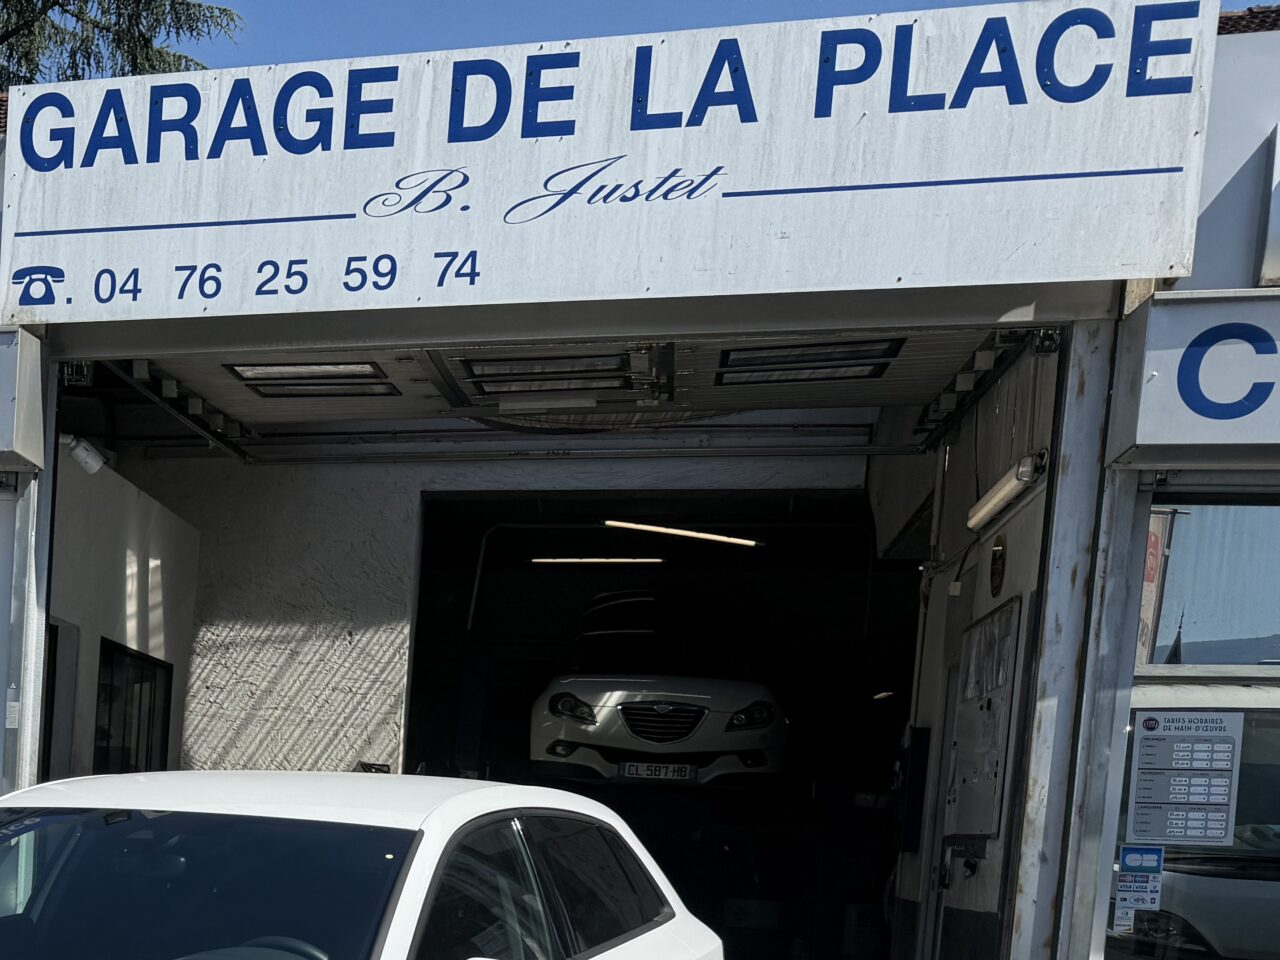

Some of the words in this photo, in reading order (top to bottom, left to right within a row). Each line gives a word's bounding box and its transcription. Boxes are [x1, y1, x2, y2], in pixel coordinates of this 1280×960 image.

[19, 66, 399, 173] GARAGE
[447, 51, 581, 144] DE
[629, 38, 758, 131] LA
[814, 1, 1200, 119] PLACE
[363, 165, 470, 219] B.
[503, 155, 728, 225] Justet
[93, 267, 142, 304] 04
[173, 263, 222, 301] 76
[255, 259, 309, 297] 25
[343, 254, 398, 292] 59
[433, 250, 480, 288] 74
[1163, 717, 1186, 725] TARIFS
